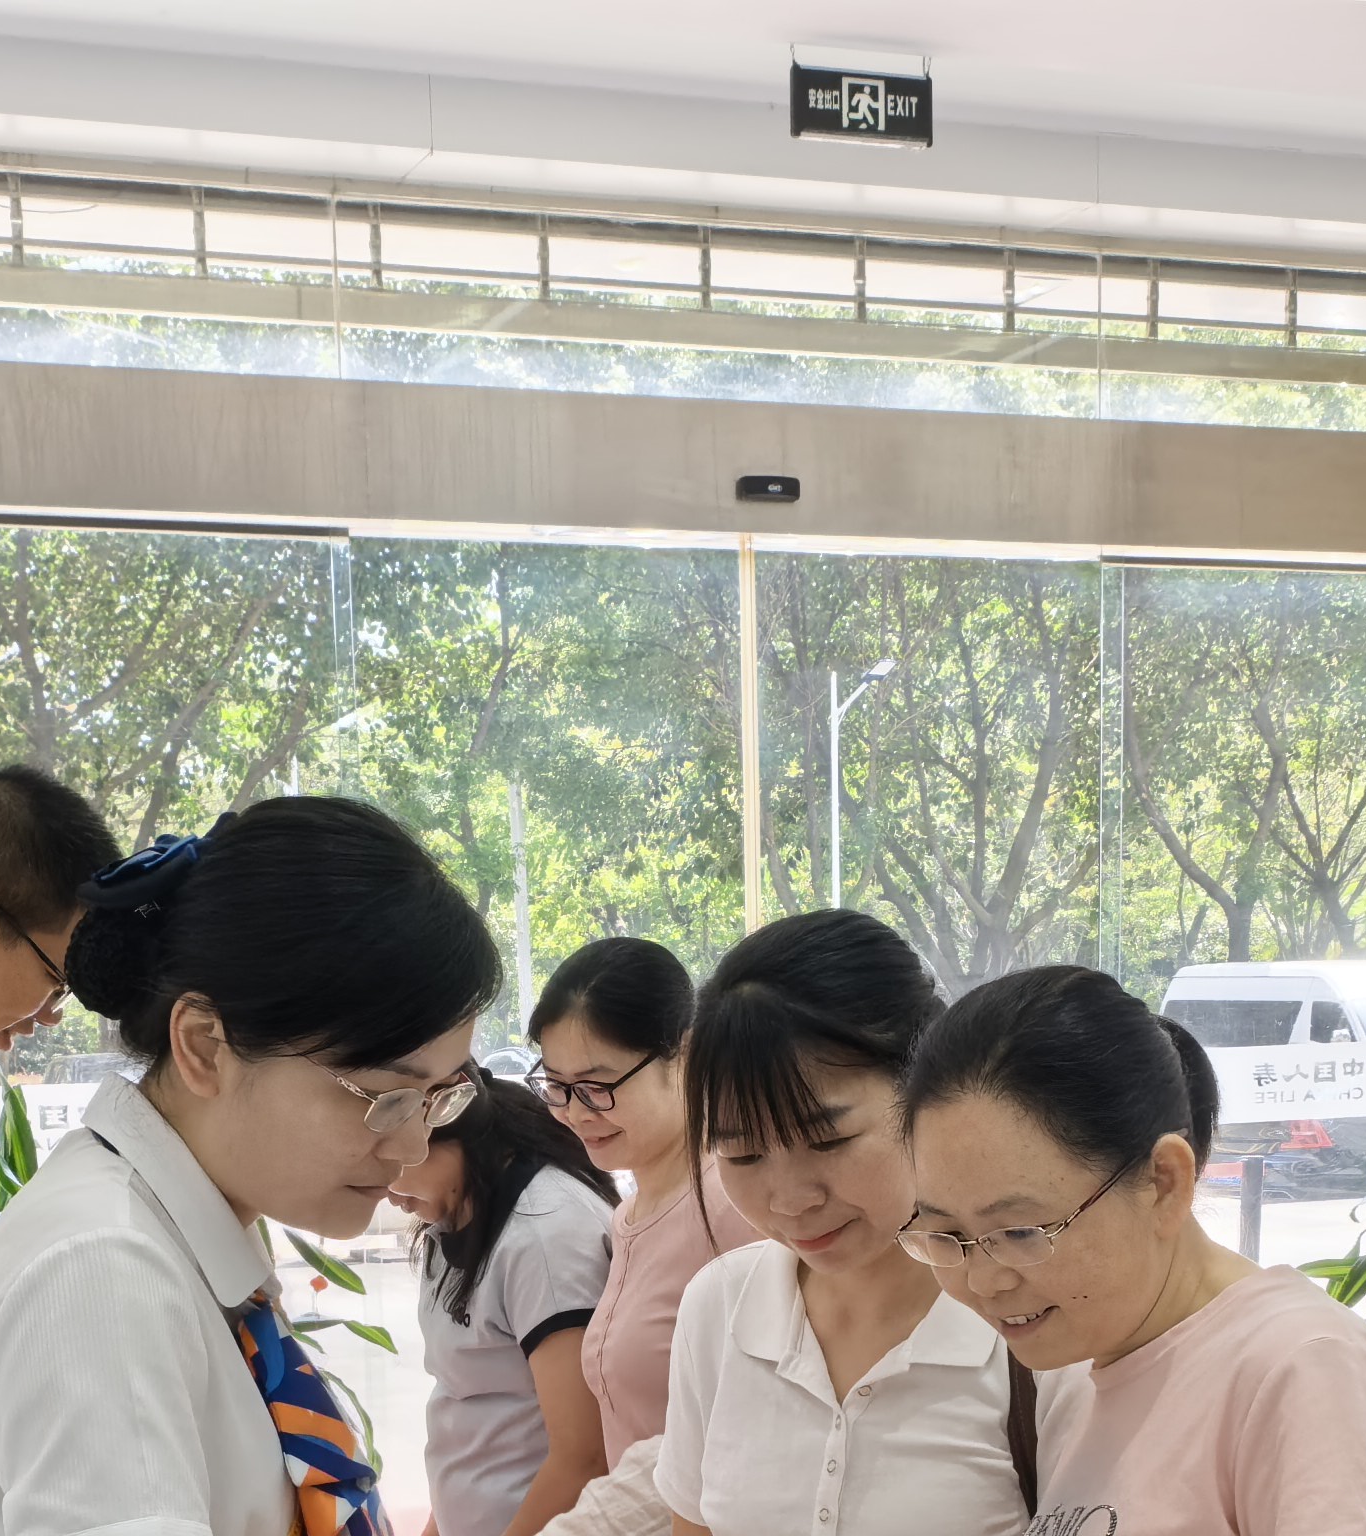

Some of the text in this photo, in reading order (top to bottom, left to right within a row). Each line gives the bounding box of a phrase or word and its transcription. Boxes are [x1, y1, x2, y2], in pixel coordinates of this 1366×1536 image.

[808, 88, 840, 111] 安全出口
[887, 94, 918, 118] EXIT
